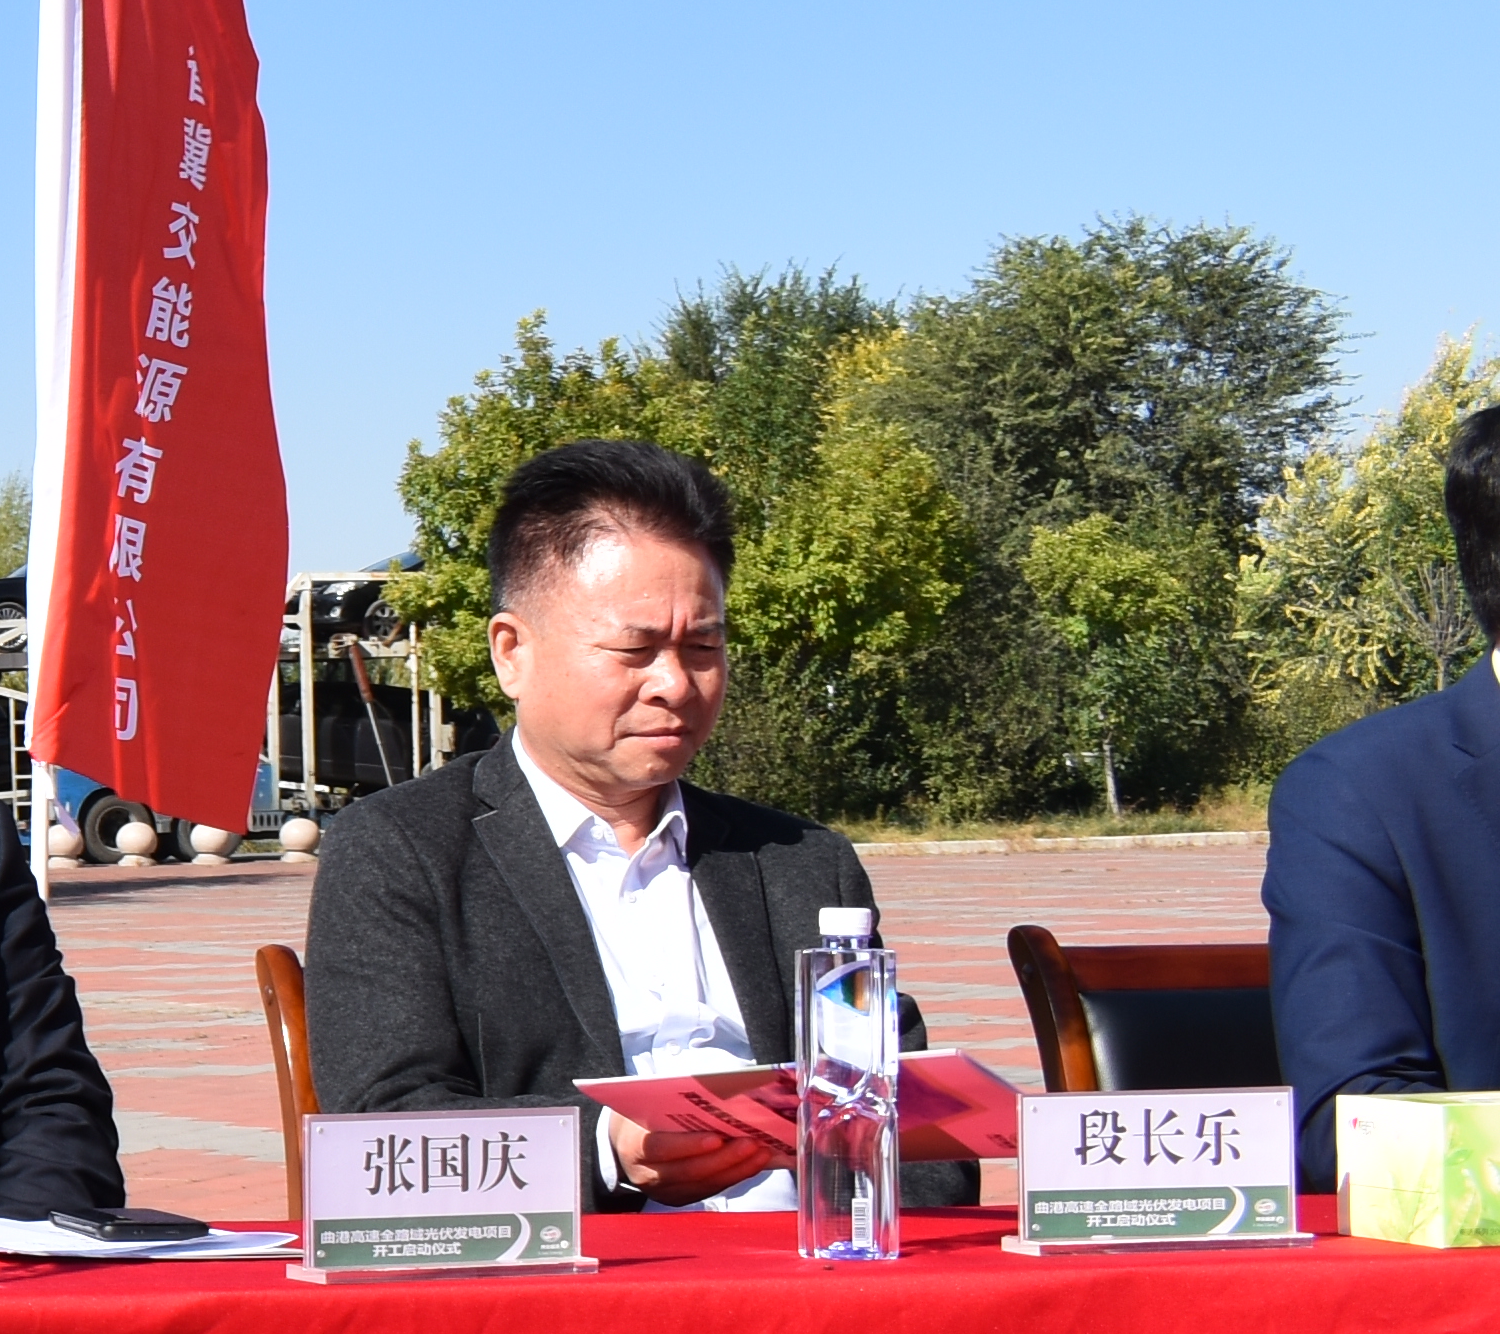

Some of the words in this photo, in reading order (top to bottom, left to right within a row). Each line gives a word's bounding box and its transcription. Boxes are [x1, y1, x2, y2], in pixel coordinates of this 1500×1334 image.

[1074, 1108, 1242, 1166] 段长乐
[363, 1131, 529, 1196] 张国庆
[1034, 1197, 1226, 1215] 曲港高速全路域光伏发电项目
[1086, 1213, 1176, 1228] 开工启动仪式
[320, 1225, 512, 1245] 曲港高速全路域光伏发电项目
[372, 1242, 462, 1258] 开工启动仪式
